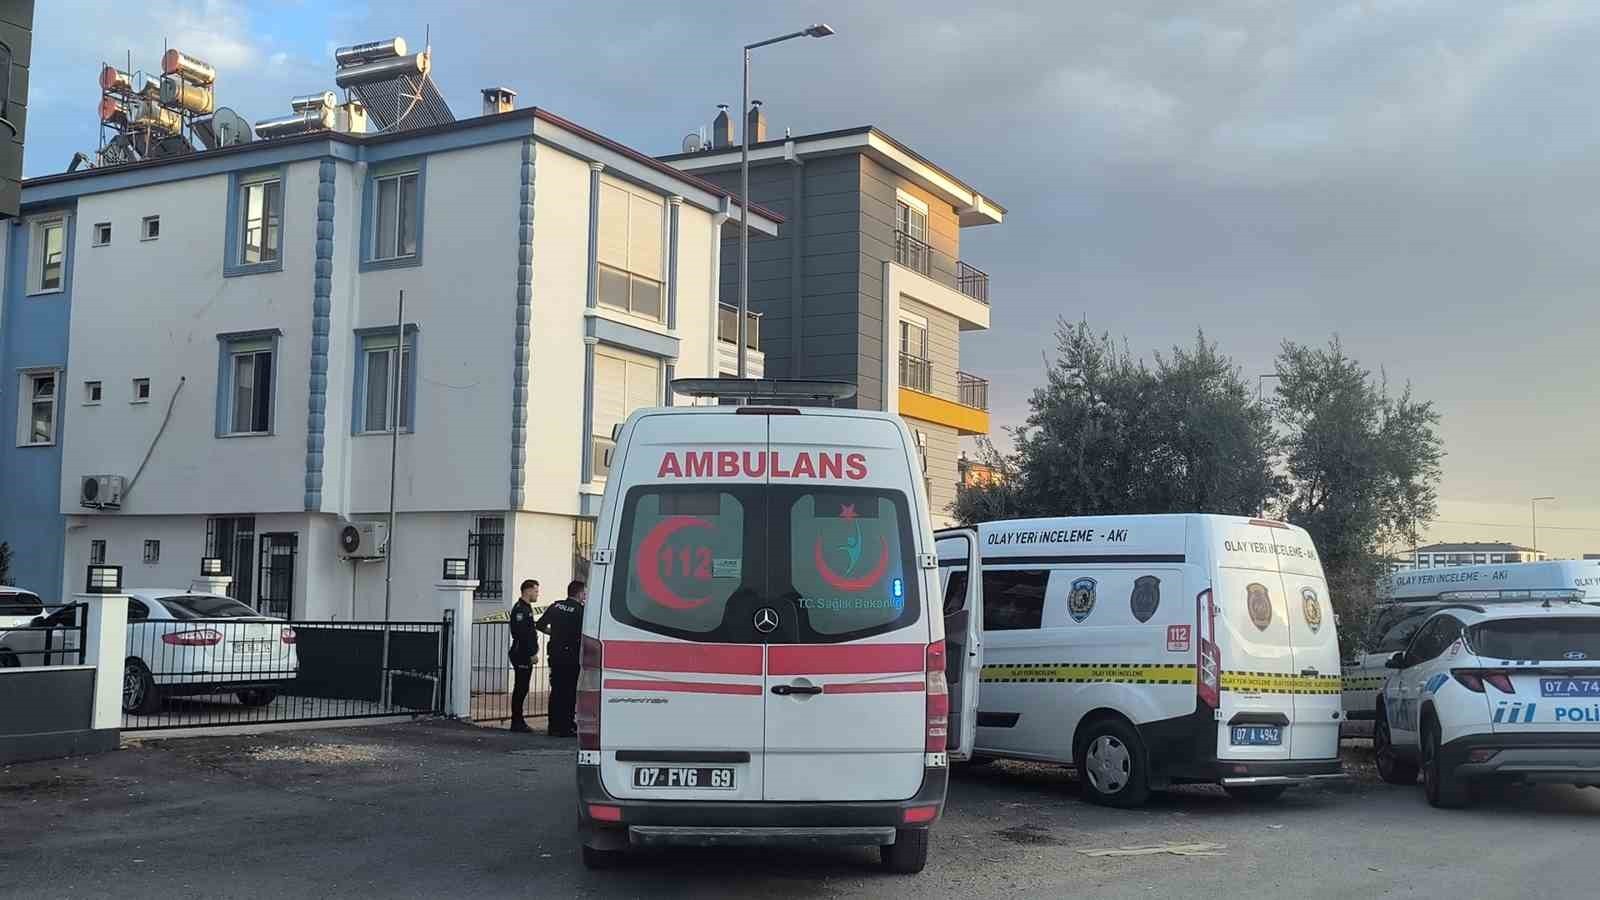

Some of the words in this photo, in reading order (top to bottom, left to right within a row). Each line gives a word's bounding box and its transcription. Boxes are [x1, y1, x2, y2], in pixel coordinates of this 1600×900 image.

[656, 451, 868, 480] AMBULANS
[987, 533, 1014, 545] OLAY
[1015, 531, 1038, 544] YERİ
[1039, 529, 1094, 543] İNCELEME
[1107, 529, 1128, 542] AKİ
[1224, 540, 1247, 552] OLAY
[657, 545, 713, 580] 112
[1396, 576, 1416, 586] OLAY
[1545, 681, 1562, 692] 07
[1567, 681, 1579, 692] A
[1581, 681, 1600, 692] 74
[1555, 703, 1600, 721] POLİ
[1236, 728, 1247, 740] 07
[1250, 728, 1256, 740] A
[1260, 728, 1279, 741] 4942
[639, 768, 660, 786] 07
[711, 769, 732, 787] 69
